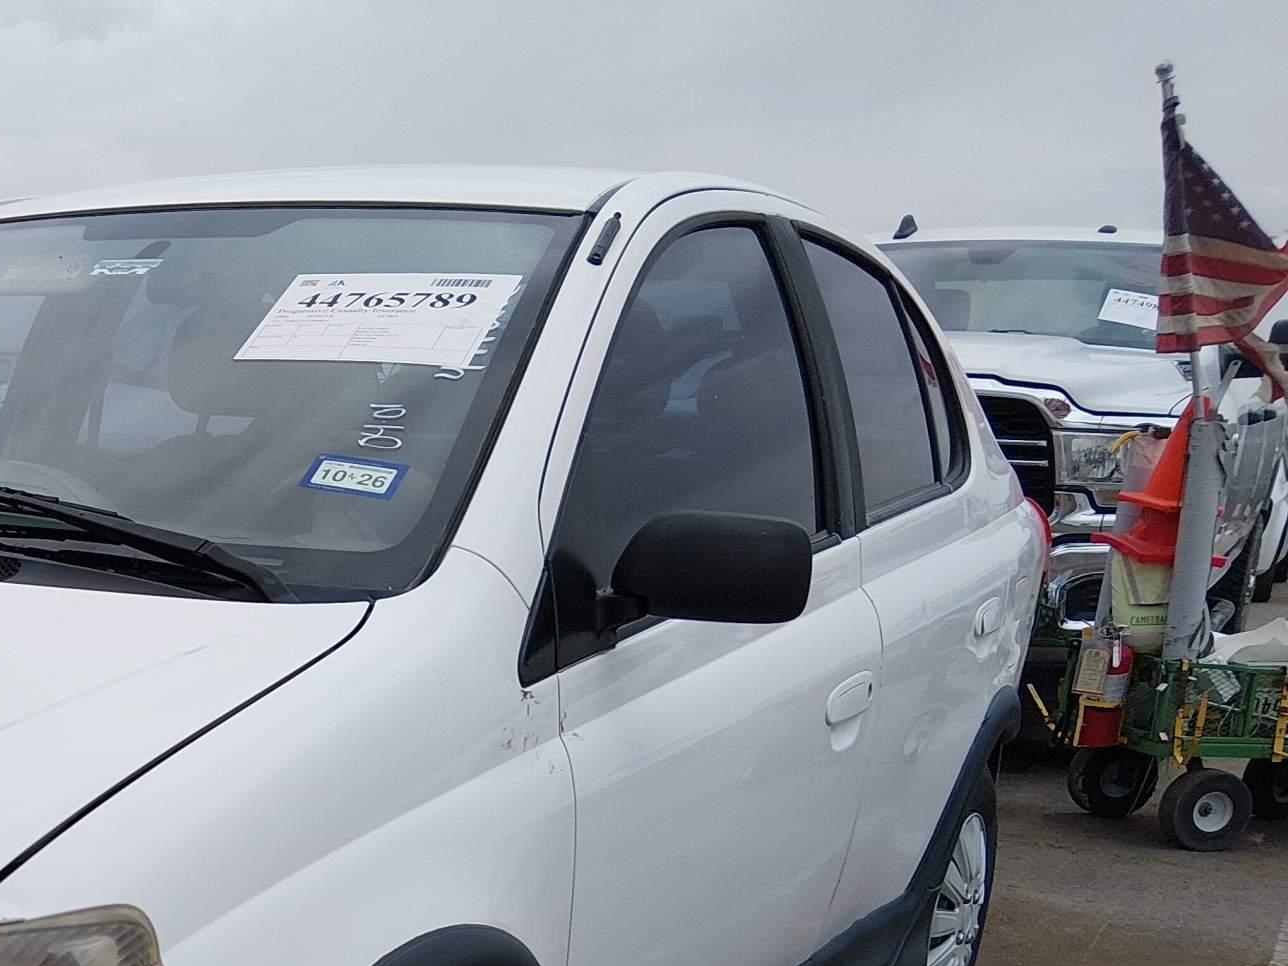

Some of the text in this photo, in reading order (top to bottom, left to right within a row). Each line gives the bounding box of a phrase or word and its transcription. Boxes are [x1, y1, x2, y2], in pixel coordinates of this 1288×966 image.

[297, 291, 478, 309] 44765789
[321, 469, 387, 488] 10 26
